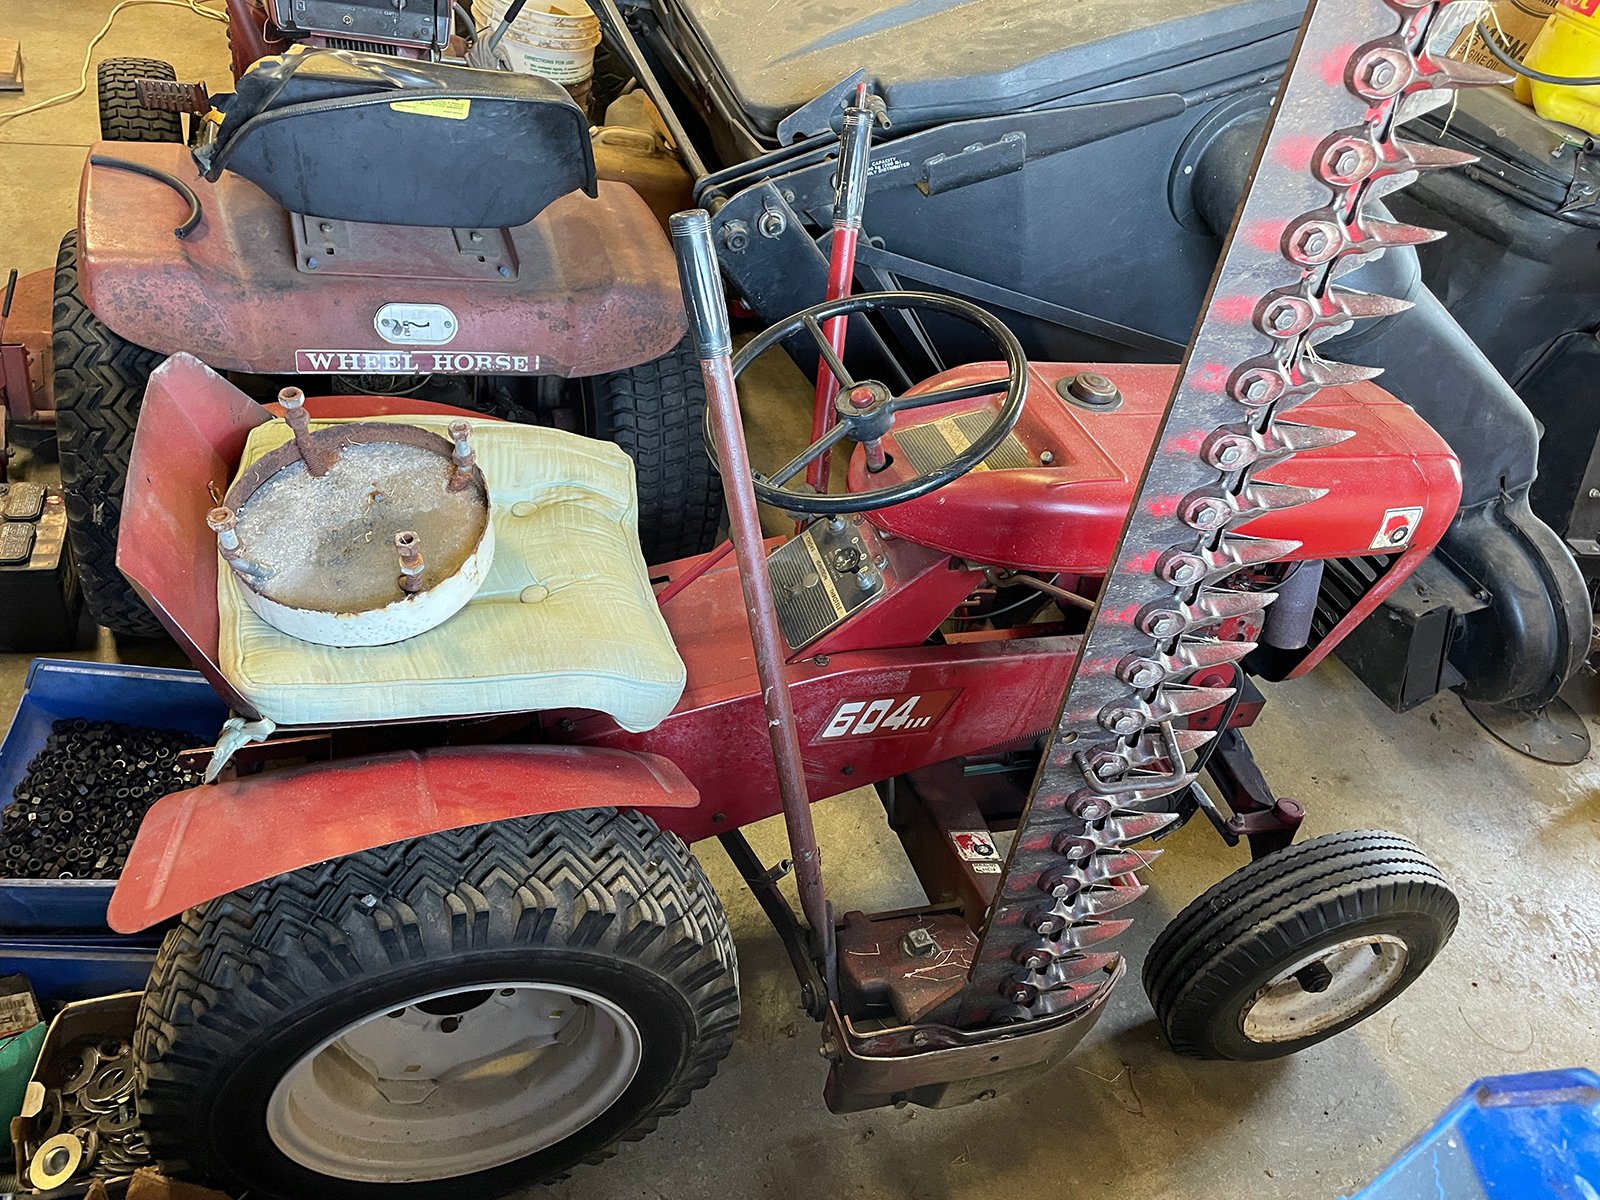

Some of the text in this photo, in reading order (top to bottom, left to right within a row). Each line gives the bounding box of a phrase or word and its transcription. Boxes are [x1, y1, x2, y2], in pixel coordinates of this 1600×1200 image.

[524, 54, 554, 65] DIRECTIONS
[305, 352, 529, 372] WHEEL HORSE
[816, 559, 829, 581] IGNITION
[830, 588, 842, 611] THROTTLE
